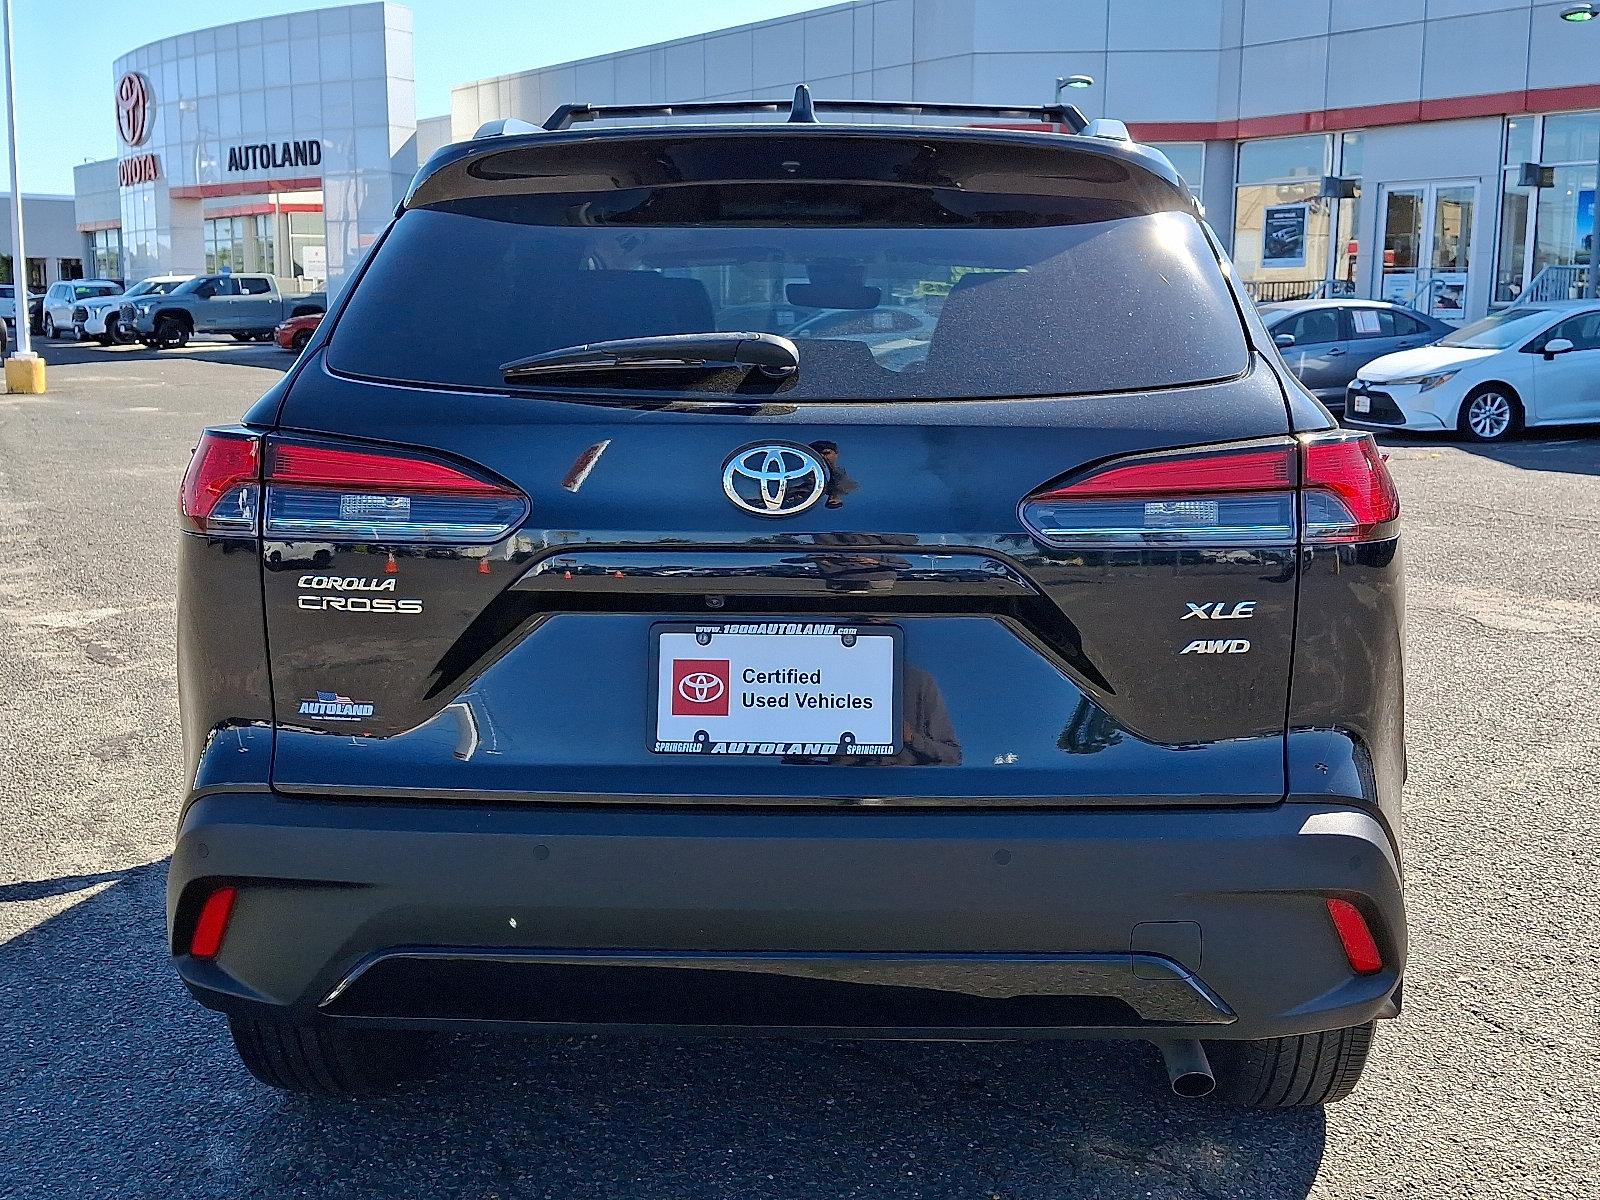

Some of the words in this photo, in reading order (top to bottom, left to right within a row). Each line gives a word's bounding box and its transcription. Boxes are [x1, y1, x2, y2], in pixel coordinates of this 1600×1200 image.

[228, 140, 321, 171] AUTOLAND
[297, 576, 396, 591] COROLLA
[298, 596, 423, 613] CROSS
[1180, 601, 1257, 620] XLE
[695, 624, 858, 635] www.1800AUTOLAND.com
[1179, 640, 1251, 654] AWD
[742, 668, 821, 684] Certified
[742, 692, 789, 708] Used
[795, 692, 873, 709] Vehicles
[299, 702, 374, 716] AUTOLAND
[654, 742, 702, 753] SPRINGFIELD
[710, 742, 838, 755] AUTOLAND
[846, 744, 894, 755] SPRINGFIELD
